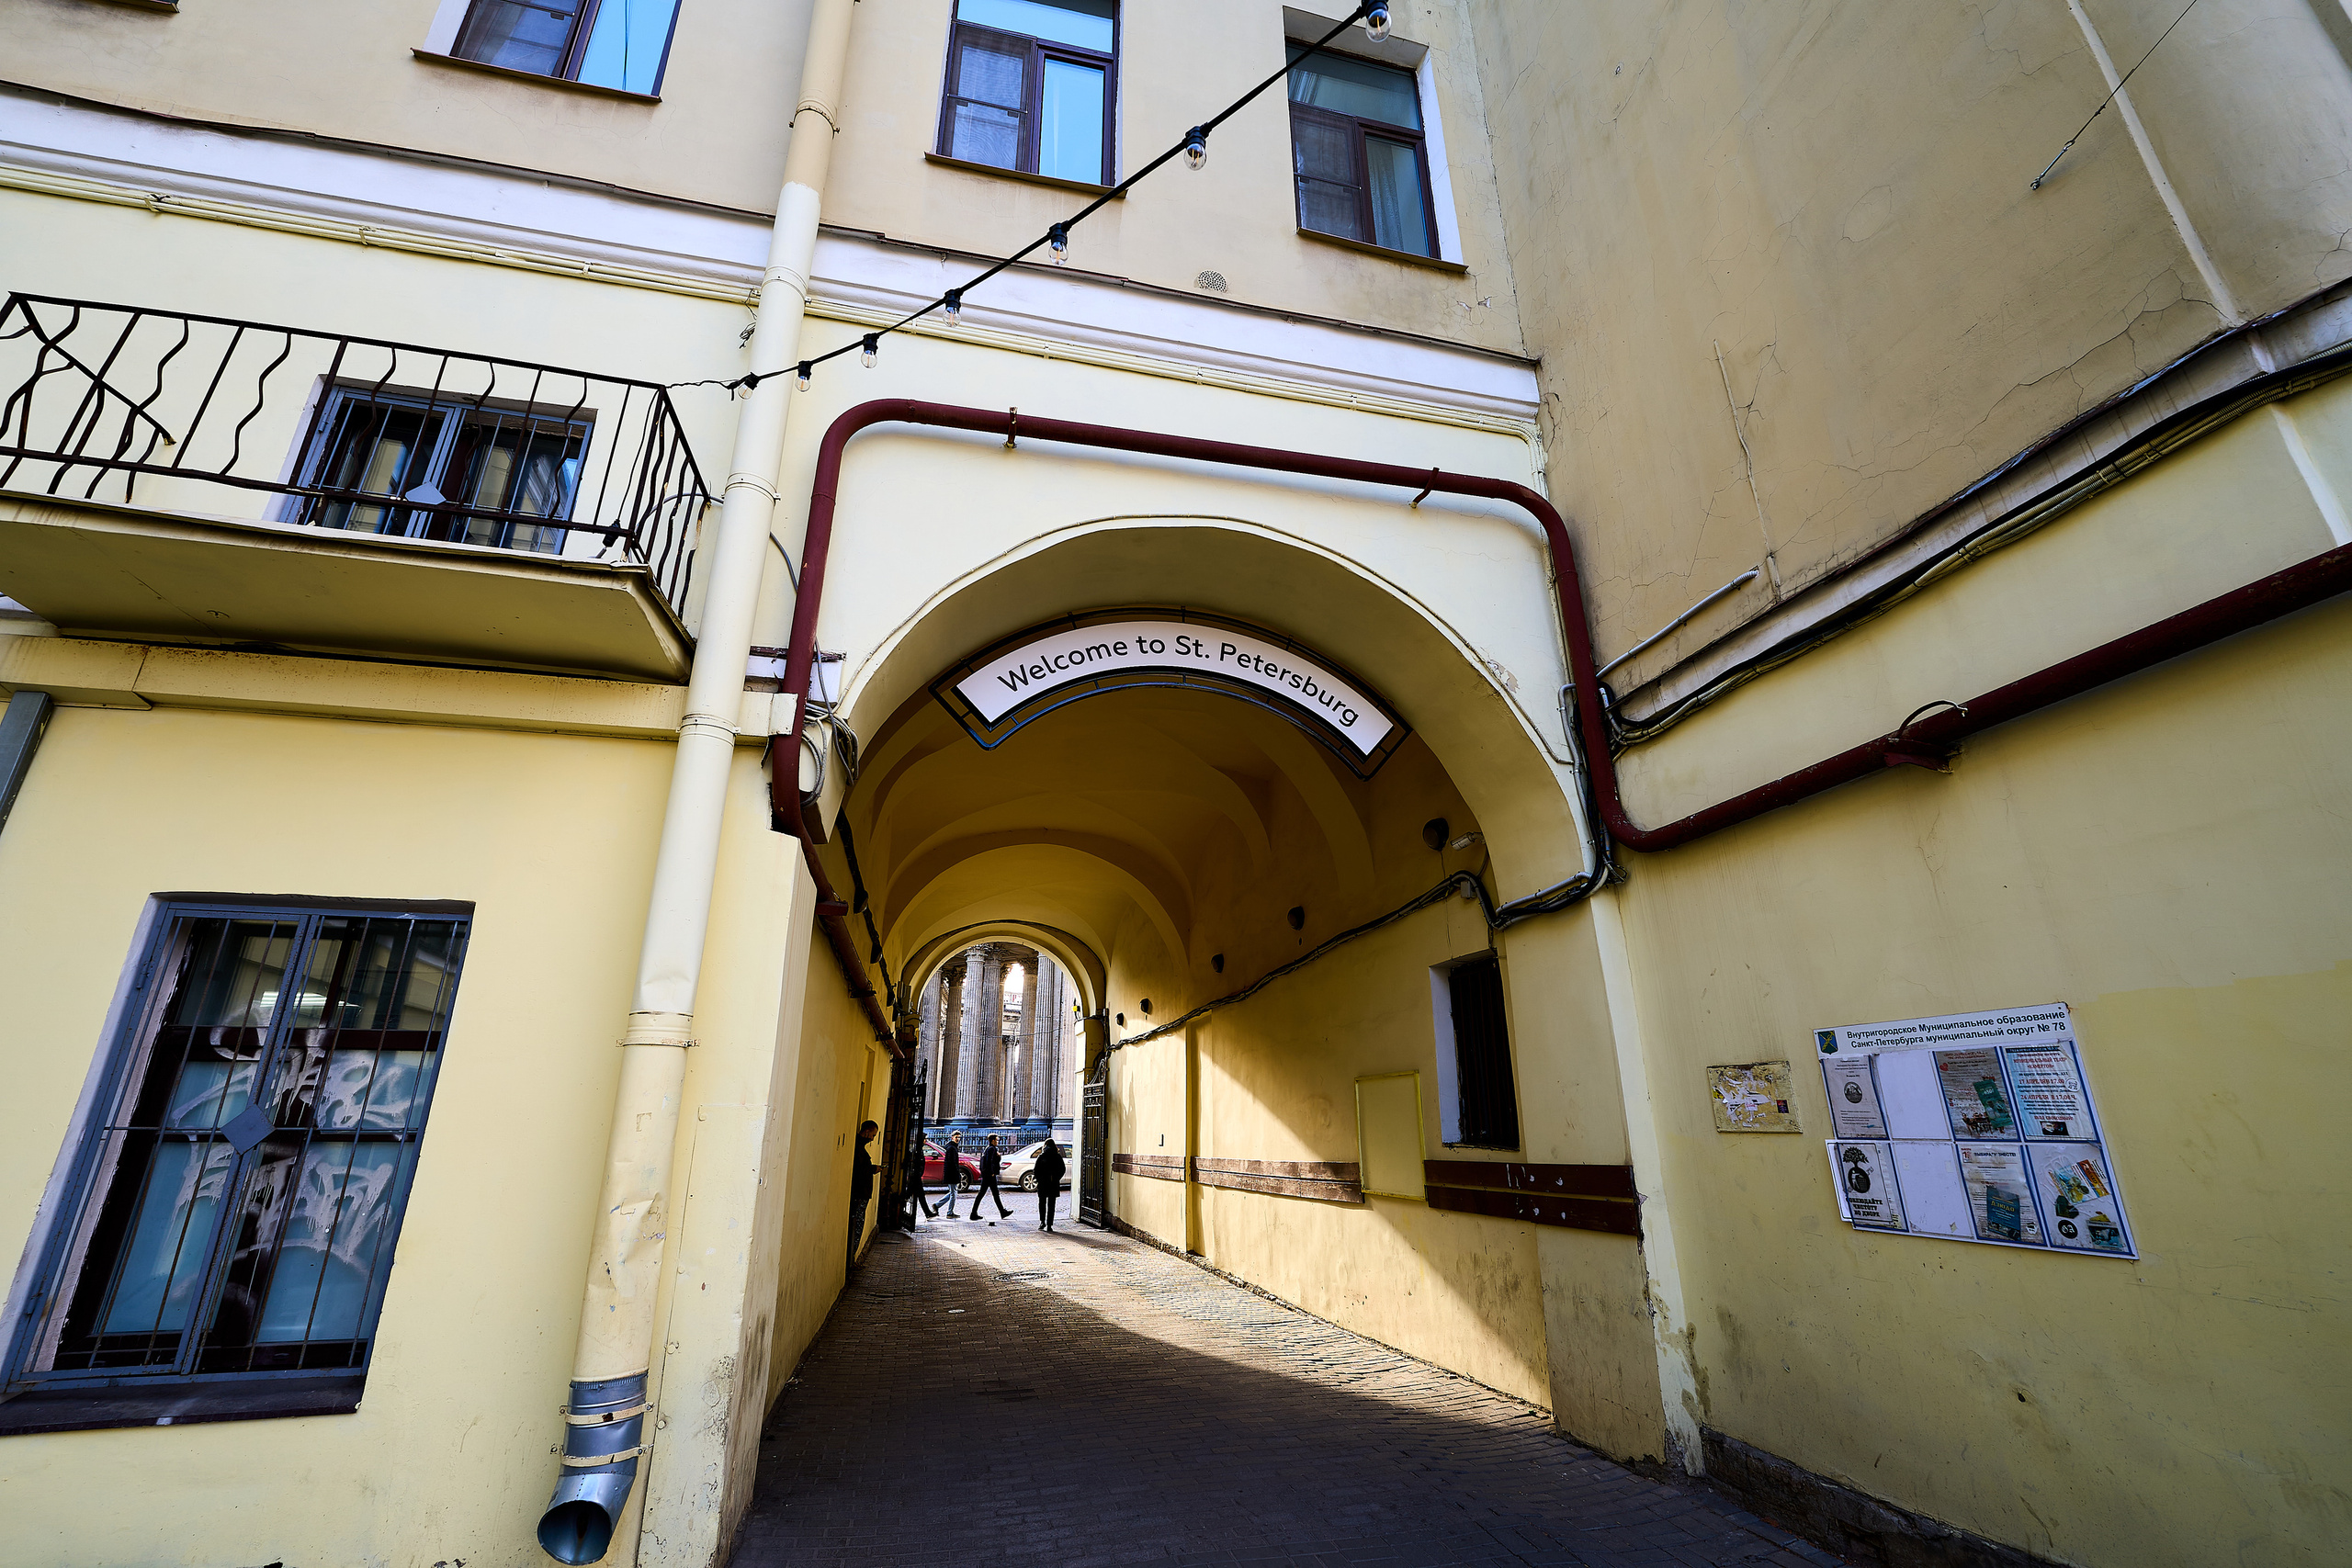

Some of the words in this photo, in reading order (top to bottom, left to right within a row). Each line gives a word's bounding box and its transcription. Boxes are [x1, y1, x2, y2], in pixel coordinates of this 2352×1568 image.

[997, 640, 1129, 694] Welcome
[1136, 634, 1166, 655] to
[1174, 635, 1211, 660] St.
[1219, 642, 1360, 728] Petersburg
[1847, 1026, 1917, 1039] Внутригородское
[1918, 1019, 1994, 1032] Муниципальное
[1996, 1011, 2065, 1025] образование
[1851, 1036, 1924, 1048] Санкт-Петербурга
[1926, 1028, 2004, 1043] муниципальный
[2007, 1026, 2035, 1036] округ
[2037, 1023, 2051, 1032] №
[2052, 1021, 2065, 1031] 78
